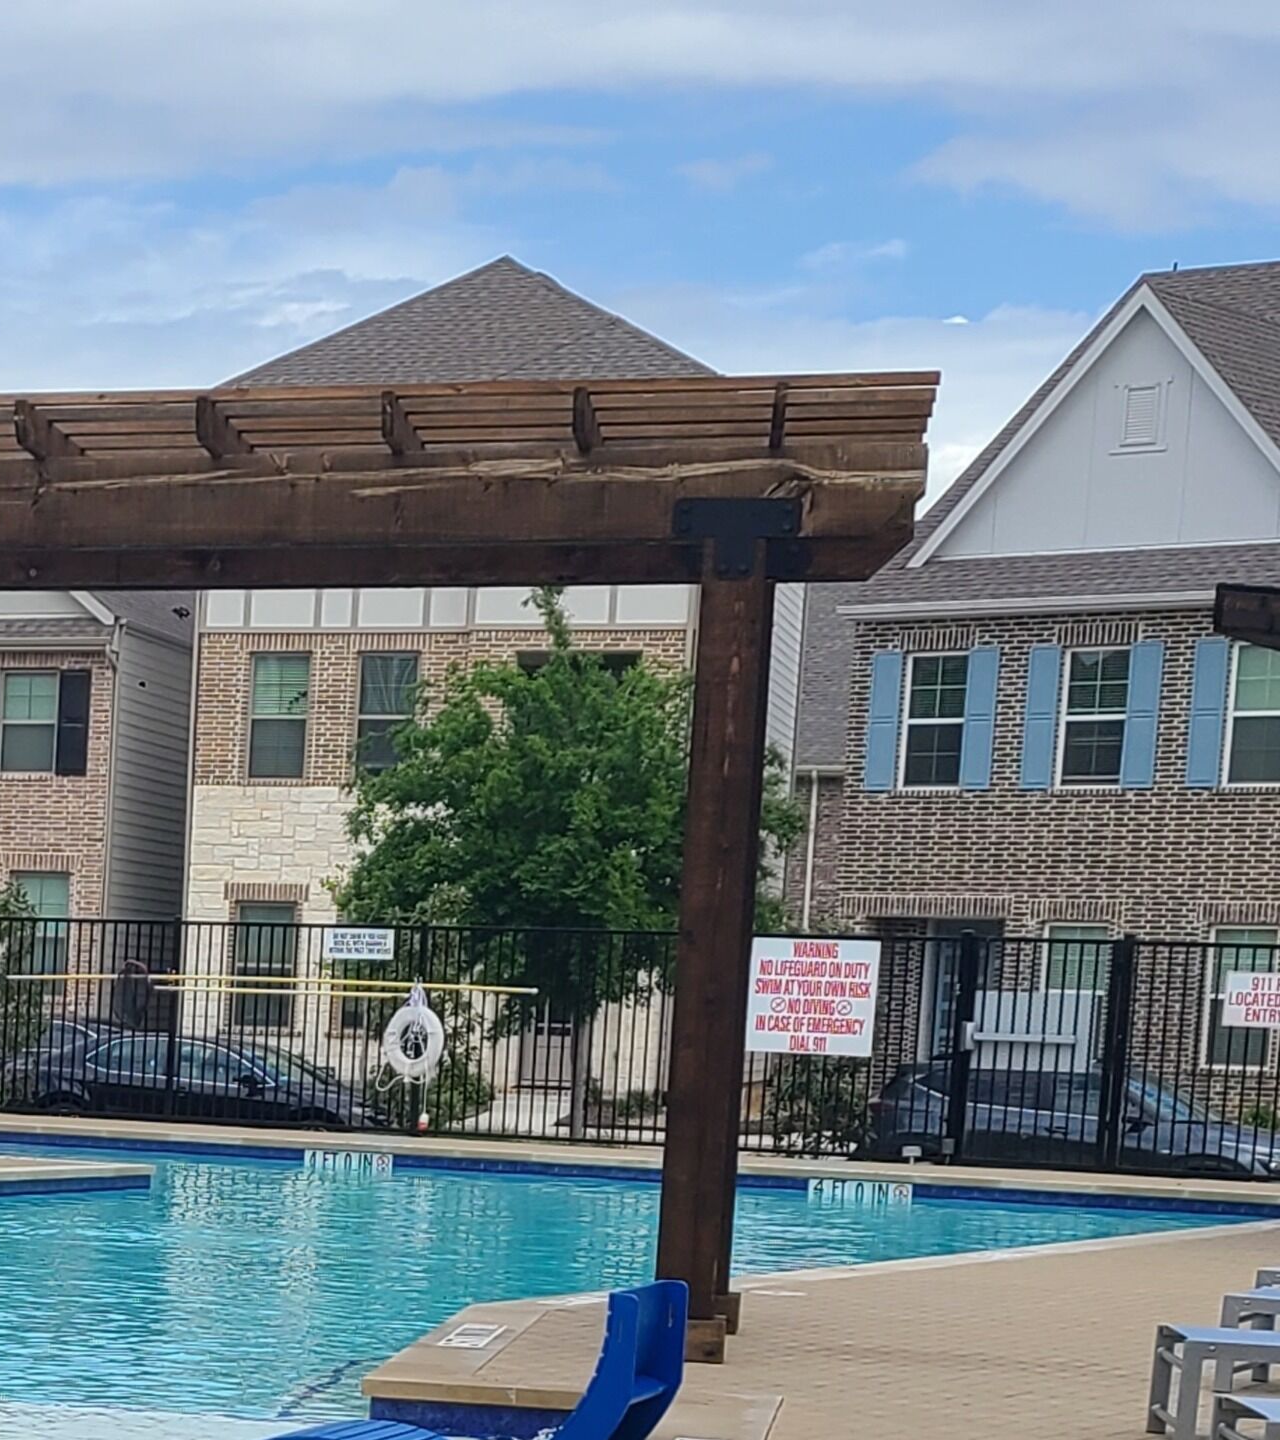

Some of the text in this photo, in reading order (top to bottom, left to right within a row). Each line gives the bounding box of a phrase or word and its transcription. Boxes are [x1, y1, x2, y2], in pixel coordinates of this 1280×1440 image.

[793, 942, 839, 959] WARNING
[759, 960, 871, 979] NO LIFEGUARD ON DUTY
[755, 978, 871, 998] SWIM AT YOUR OWN RISK
[1251, 977, 1272, 991] 911
[786, 999, 836, 1015] NO DIVING
[1228, 991, 1280, 1007] LOCATED
[755, 1015, 865, 1035] IN CASE OF EMERGENCY
[790, 1035, 827, 1052] DIAL 911
[323, 1152, 339, 1172] FT
[813, 1179, 824, 1204] 4
[832, 1180, 847, 1206] FT
[871, 1183, 888, 1206] IN
